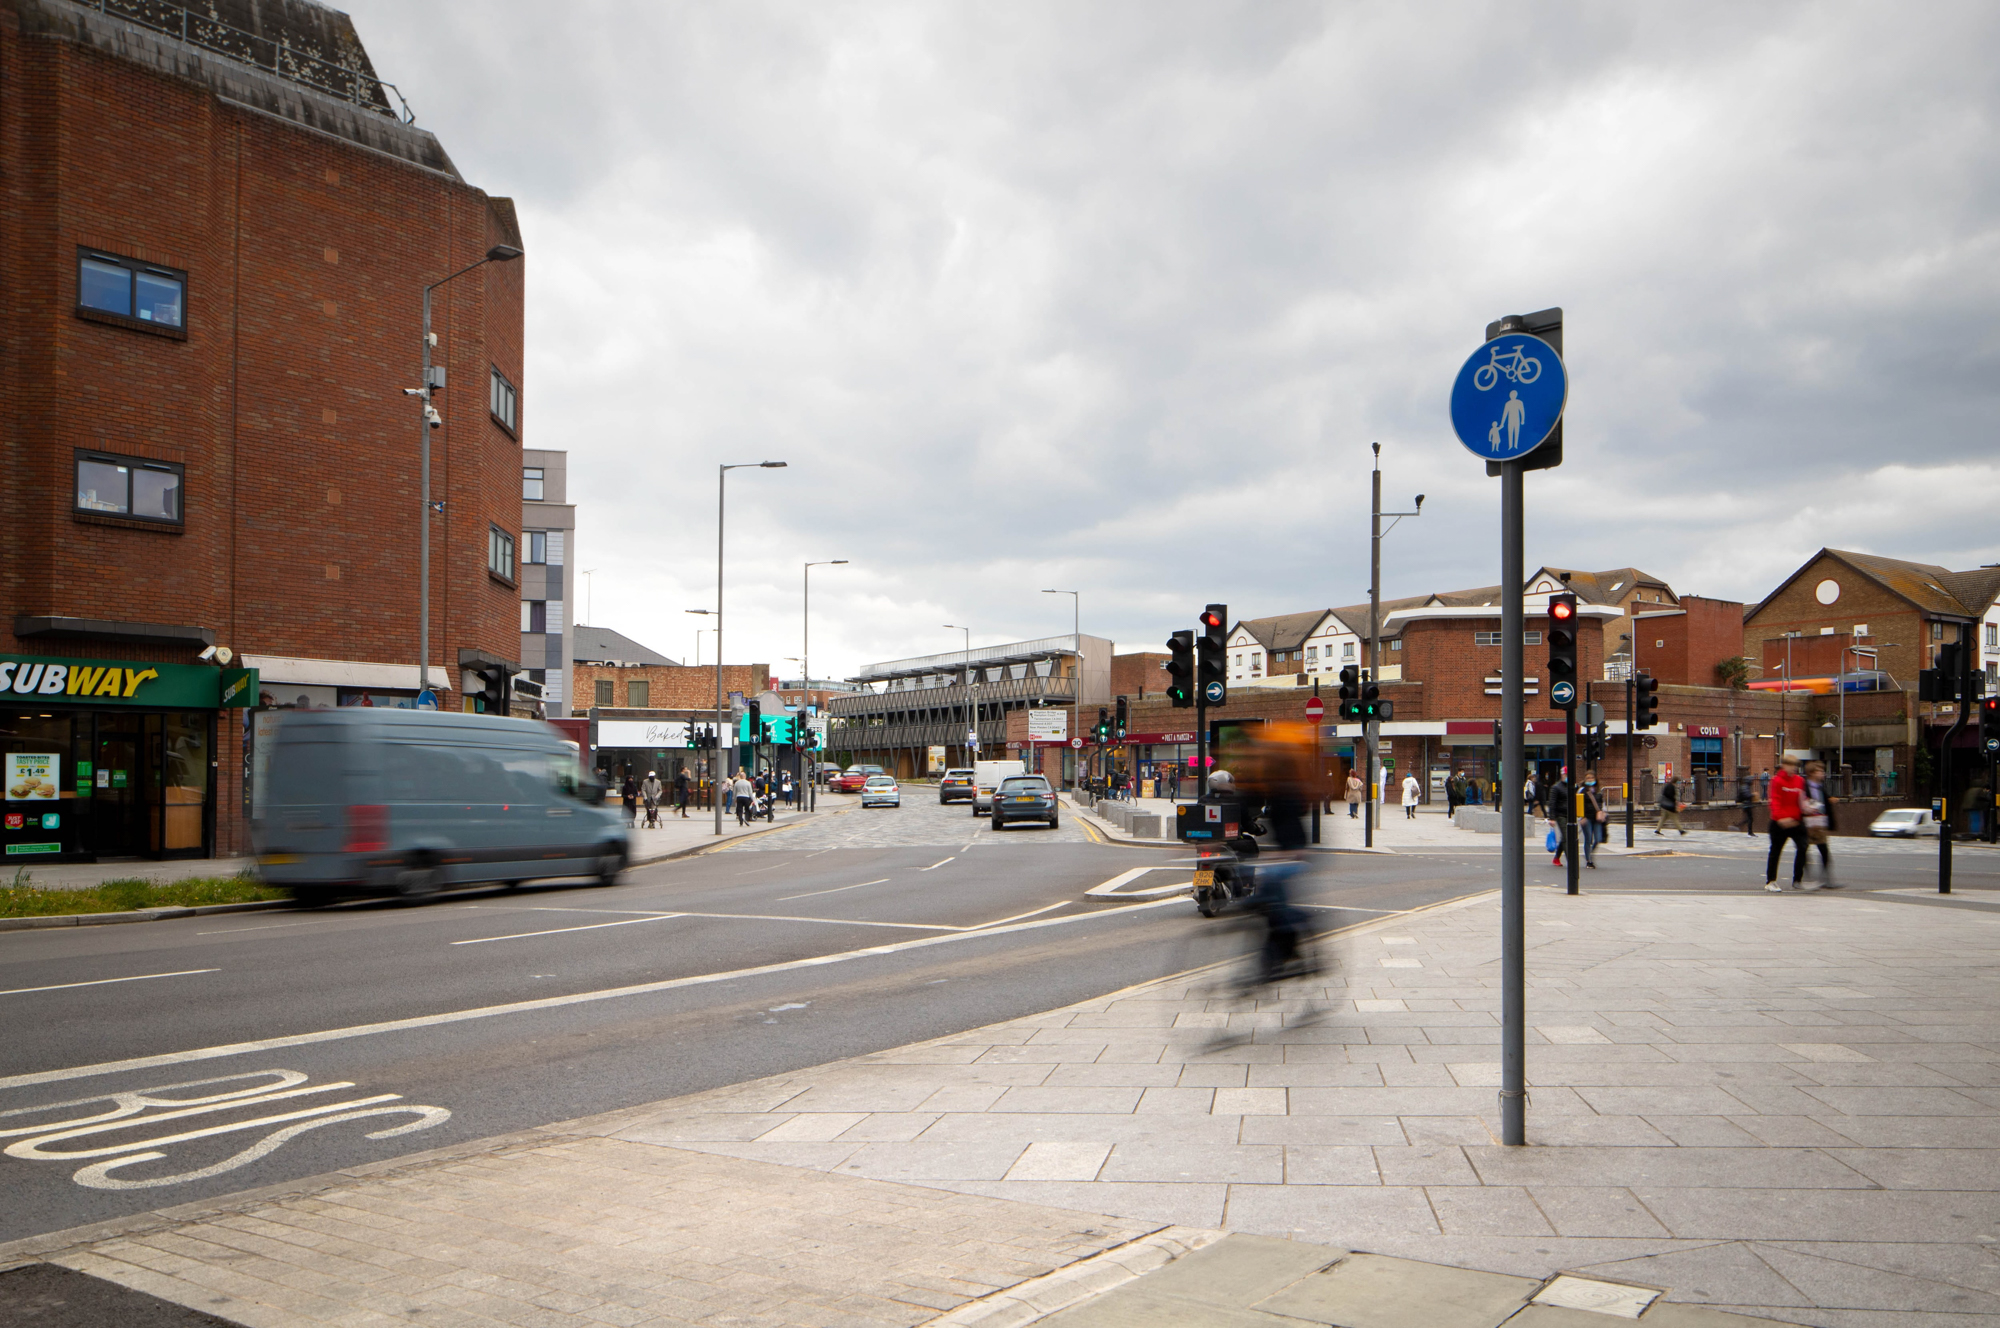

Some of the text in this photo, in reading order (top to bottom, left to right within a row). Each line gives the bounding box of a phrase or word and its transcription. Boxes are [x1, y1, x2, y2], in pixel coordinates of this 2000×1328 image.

[0, 662, 158, 697] SUBWAY
[223, 673, 250, 702] SUBWAY
[646, 725, 685, 744] Baked
[1176, 732, 1190, 741] MANGER
[1700, 726, 1719, 736] COSTA
[1209, 809, 1217, 818] L
[0, 1068, 451, 1190] BUS
